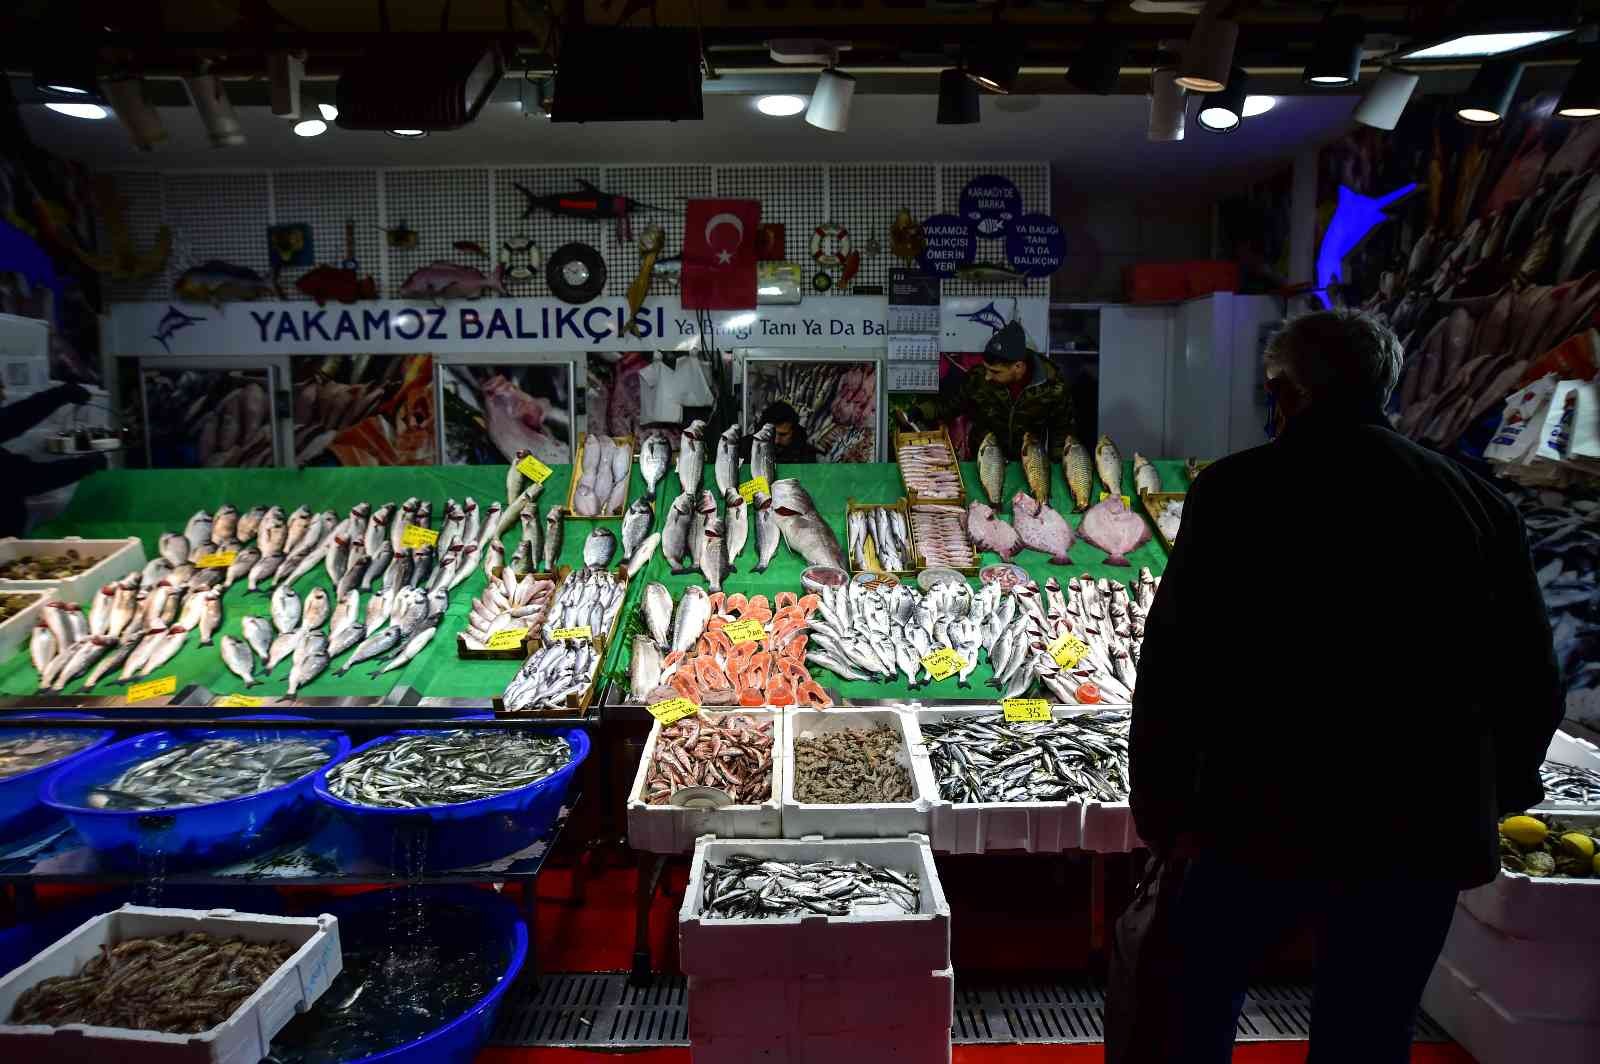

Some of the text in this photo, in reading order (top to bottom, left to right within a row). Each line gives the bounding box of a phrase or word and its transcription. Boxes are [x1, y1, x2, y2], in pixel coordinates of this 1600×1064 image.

[922, 225, 968, 236] YAKAMOZ
[251, 308, 447, 343] YAKAMOZ
[675, 319, 696, 335] Ya
[802, 319, 826, 336] Ya
[831, 319, 855, 336] Da
